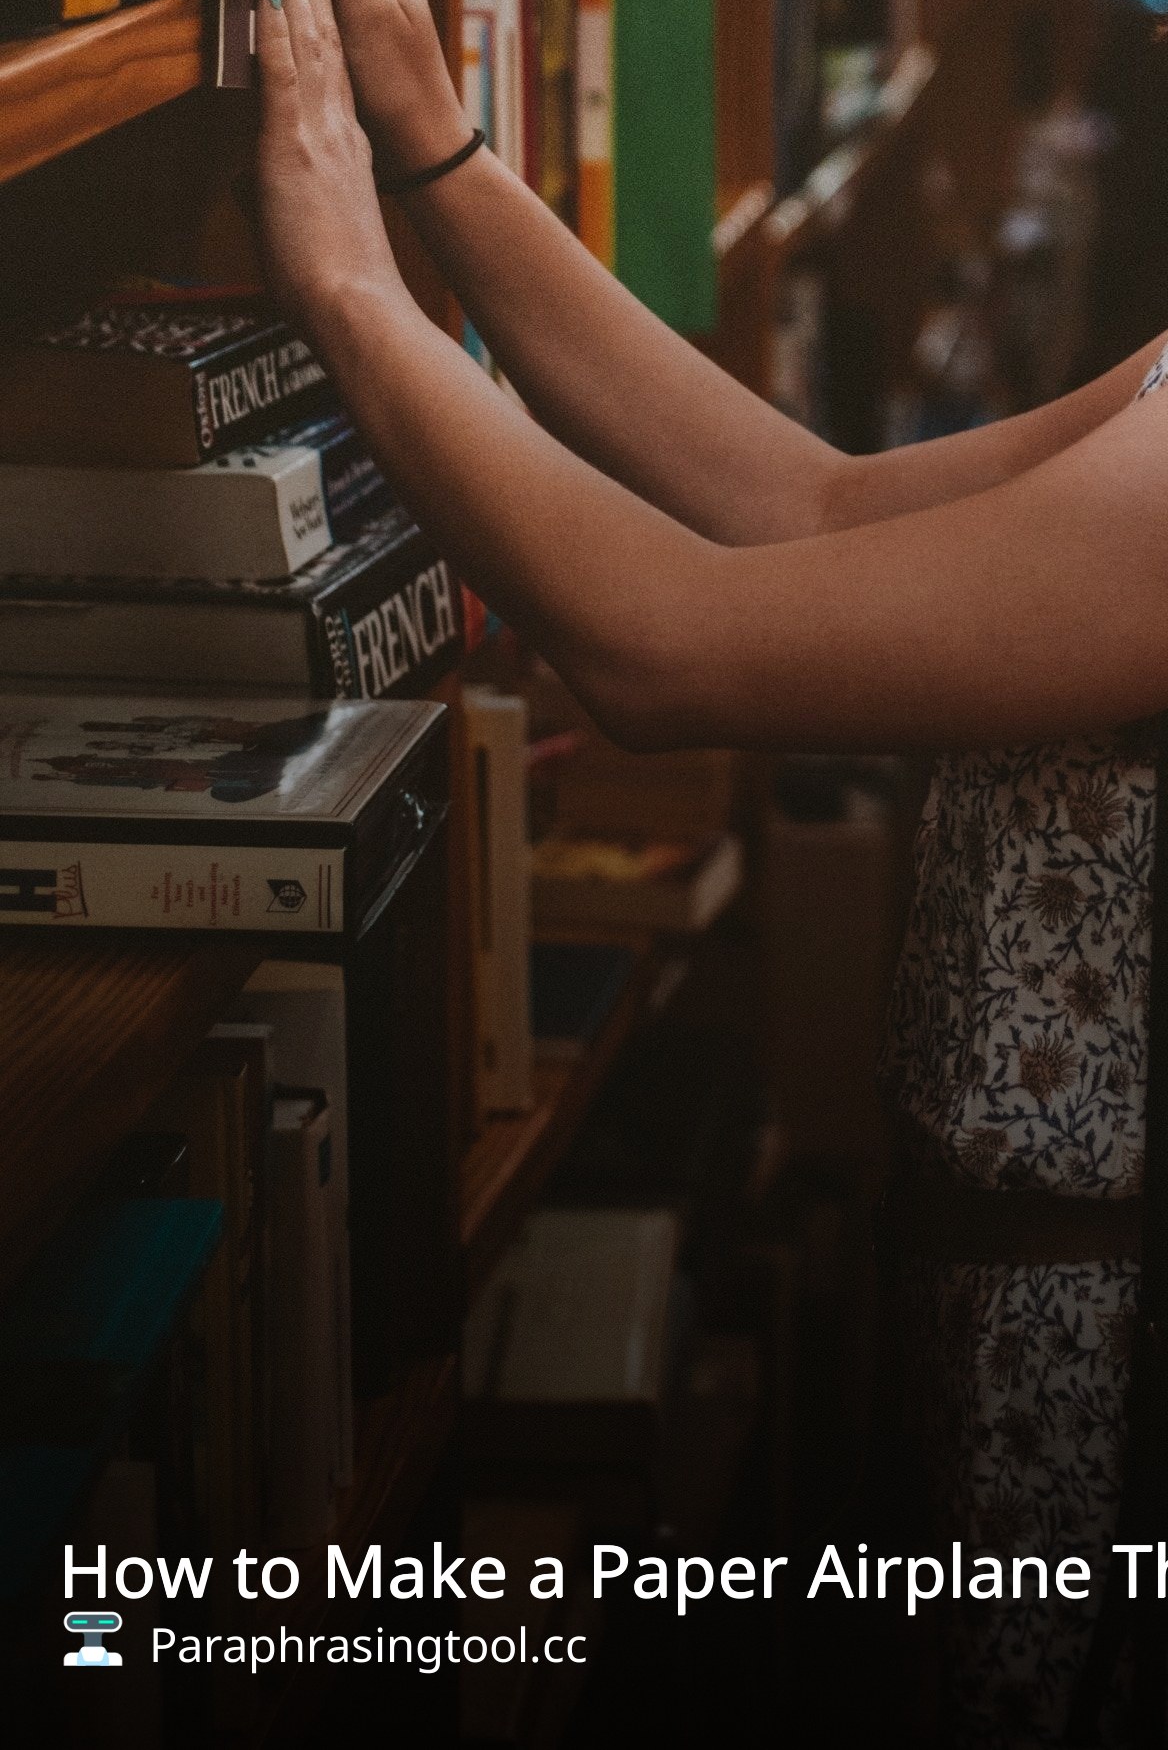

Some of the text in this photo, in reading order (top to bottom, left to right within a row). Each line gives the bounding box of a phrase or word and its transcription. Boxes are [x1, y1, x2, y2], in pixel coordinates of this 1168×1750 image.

[208, 350, 281, 430] FRENCH
[352, 559, 456, 700] FRENCH
[163, 871, 173, 914] Improving
[186, 879, 194, 908] French
[210, 861, 219, 927] Communicating
[232, 874, 241, 917] Effectively
